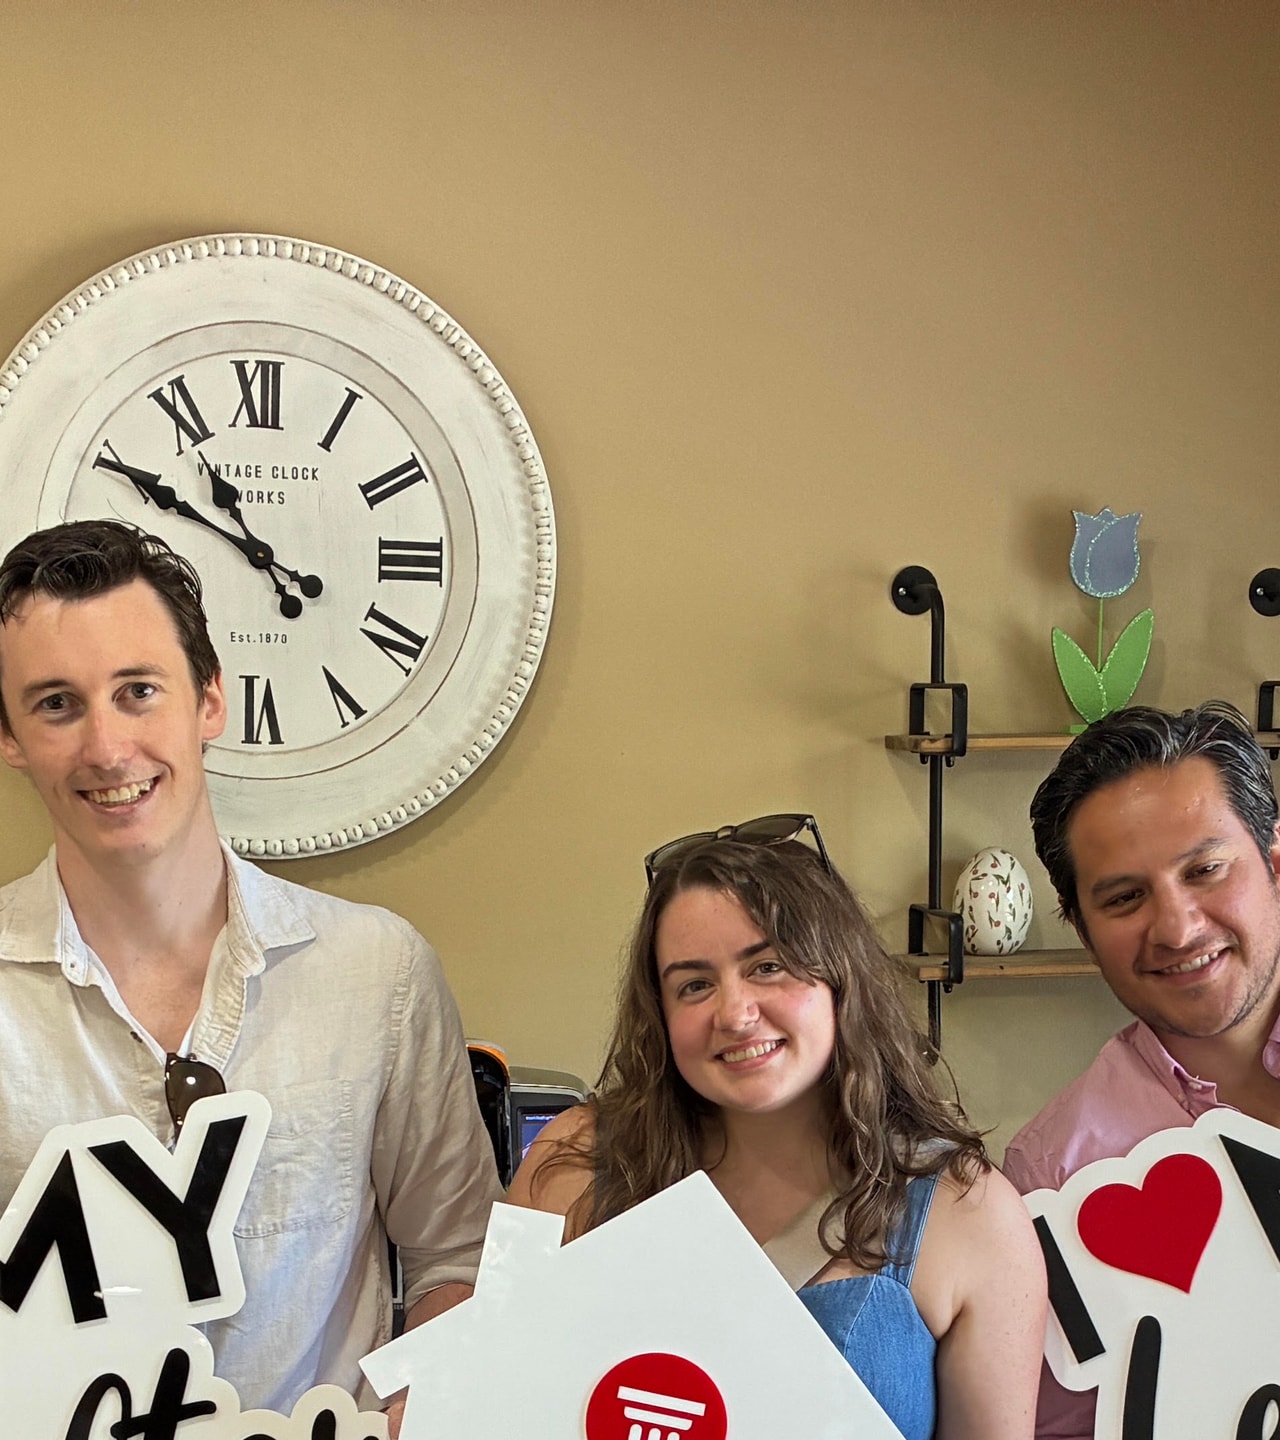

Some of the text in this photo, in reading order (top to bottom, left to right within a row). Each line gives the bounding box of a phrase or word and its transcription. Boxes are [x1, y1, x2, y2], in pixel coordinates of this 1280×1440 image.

[148, 375, 215, 456] XI
[229, 360, 285, 431] XII
[318, 386, 363, 452] I
[198, 462, 319, 481] VNTAGE CLOCK
[358, 452, 430, 510] II
[378, 537, 443, 588] III
[322, 666, 367, 728] V
[1032, 1215, 1106, 1364] I
